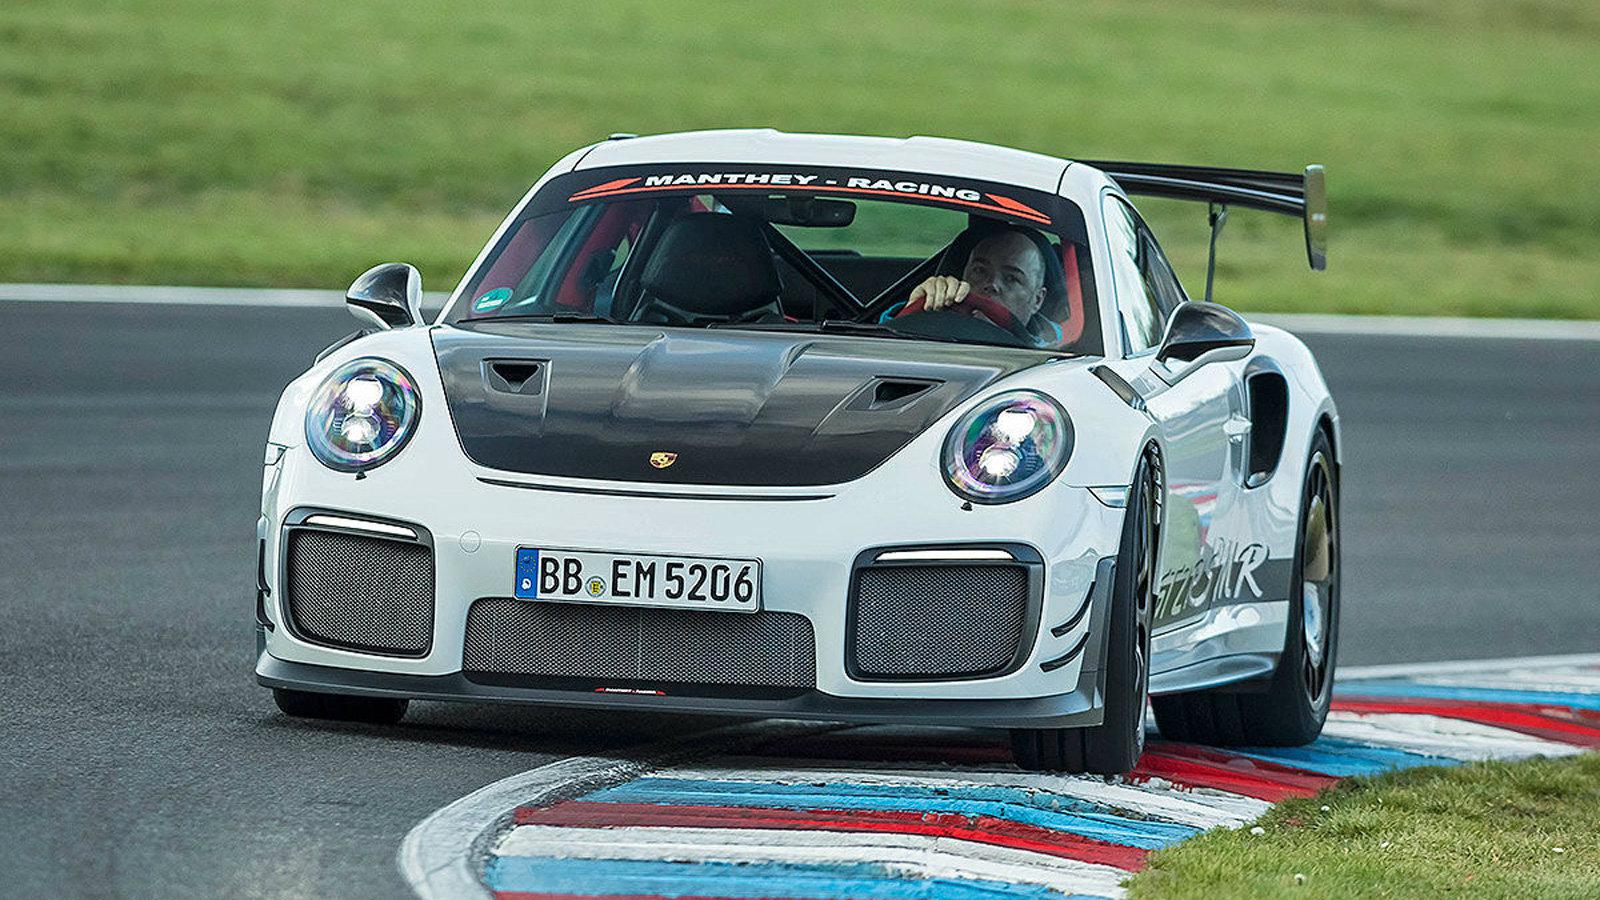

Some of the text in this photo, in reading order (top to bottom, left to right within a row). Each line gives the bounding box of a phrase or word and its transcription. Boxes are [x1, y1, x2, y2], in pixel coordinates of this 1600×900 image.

[644, 173, 818, 187] MANTHEY
[846, 177, 982, 202] RACING
[540, 556, 754, 603] BB EM 5206
